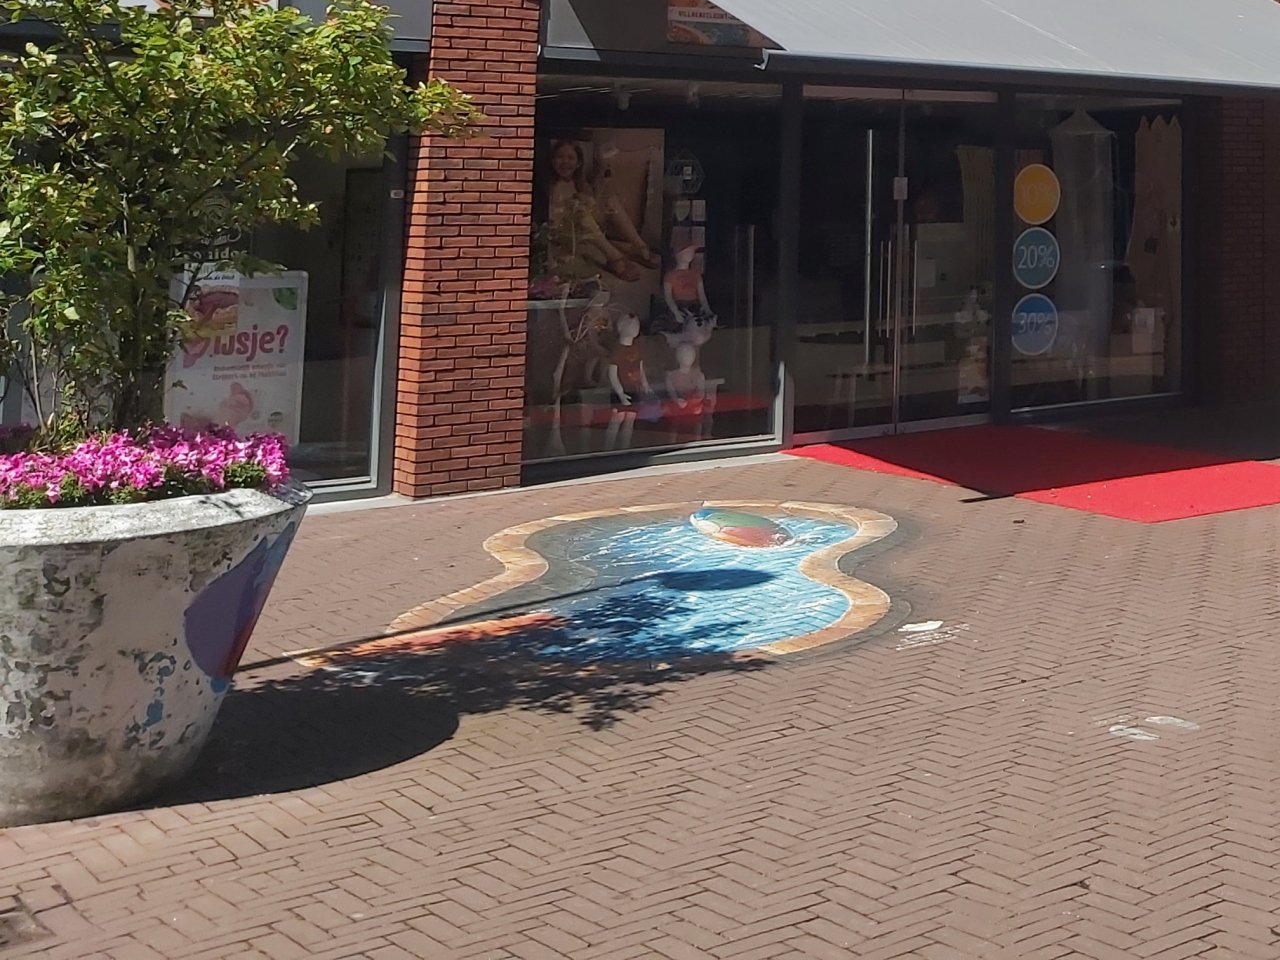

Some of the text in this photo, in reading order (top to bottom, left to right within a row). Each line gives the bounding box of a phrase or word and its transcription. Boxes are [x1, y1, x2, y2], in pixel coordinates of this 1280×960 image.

[1022, 183, 1054, 206] 10%
[1017, 245, 1055, 269] 20%
[1018, 311, 1054, 335] 30%
